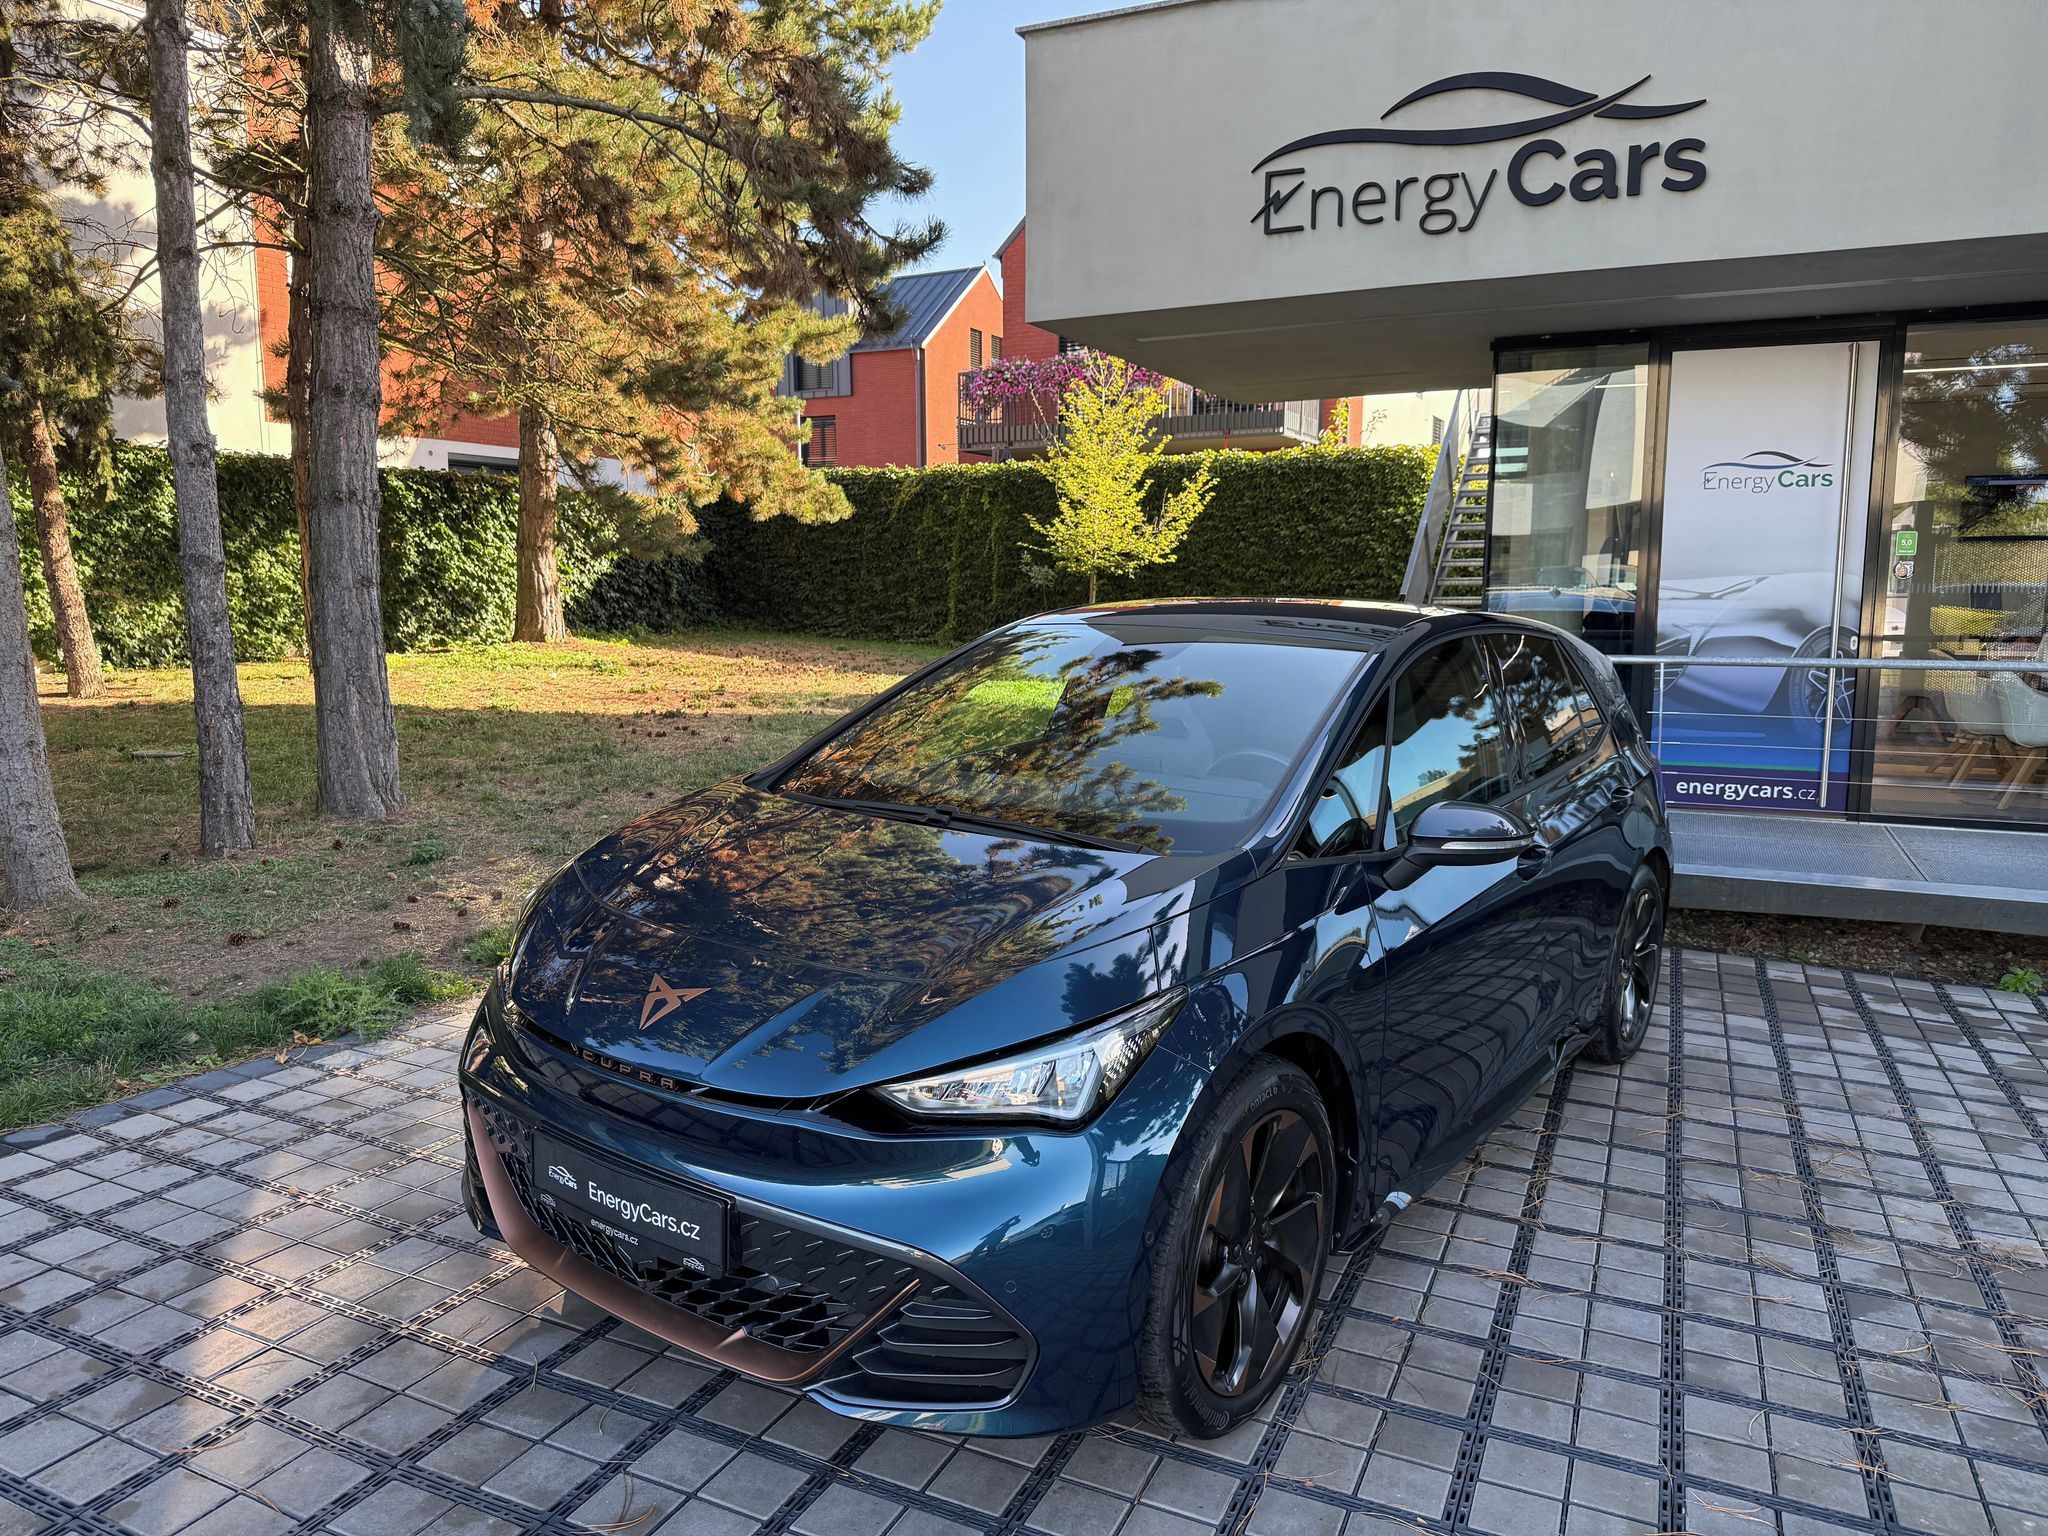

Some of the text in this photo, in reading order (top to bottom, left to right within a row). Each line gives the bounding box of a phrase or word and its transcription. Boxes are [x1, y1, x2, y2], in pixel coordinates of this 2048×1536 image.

[1675, 780, 1817, 801] energycars.cz
[582, 1049, 674, 1089] CUPRA
[588, 1180, 701, 1241] EnergyCars.cz
[590, 1218, 639, 1246] energycars.cz
